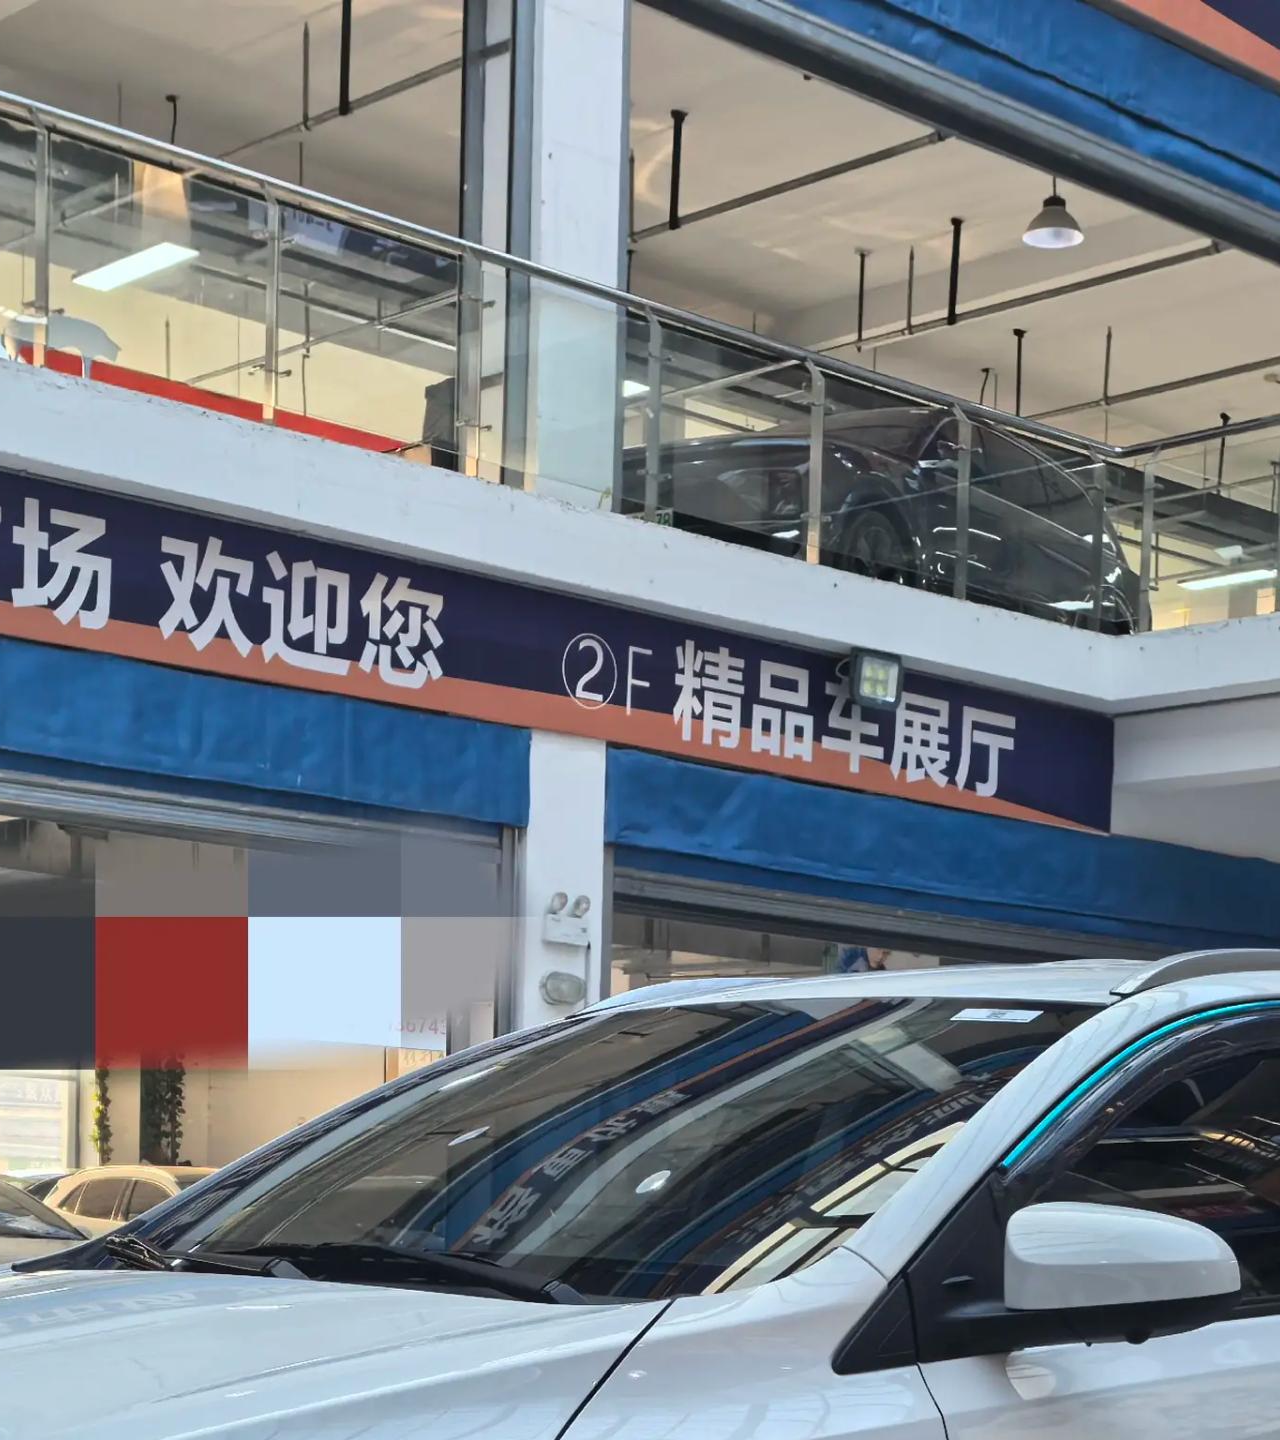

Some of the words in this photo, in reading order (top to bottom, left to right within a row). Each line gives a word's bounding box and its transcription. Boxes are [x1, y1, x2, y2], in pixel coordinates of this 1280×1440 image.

[157, 534, 445, 690] 欢迎您
[672, 639, 1017, 798] 精品车展厅
